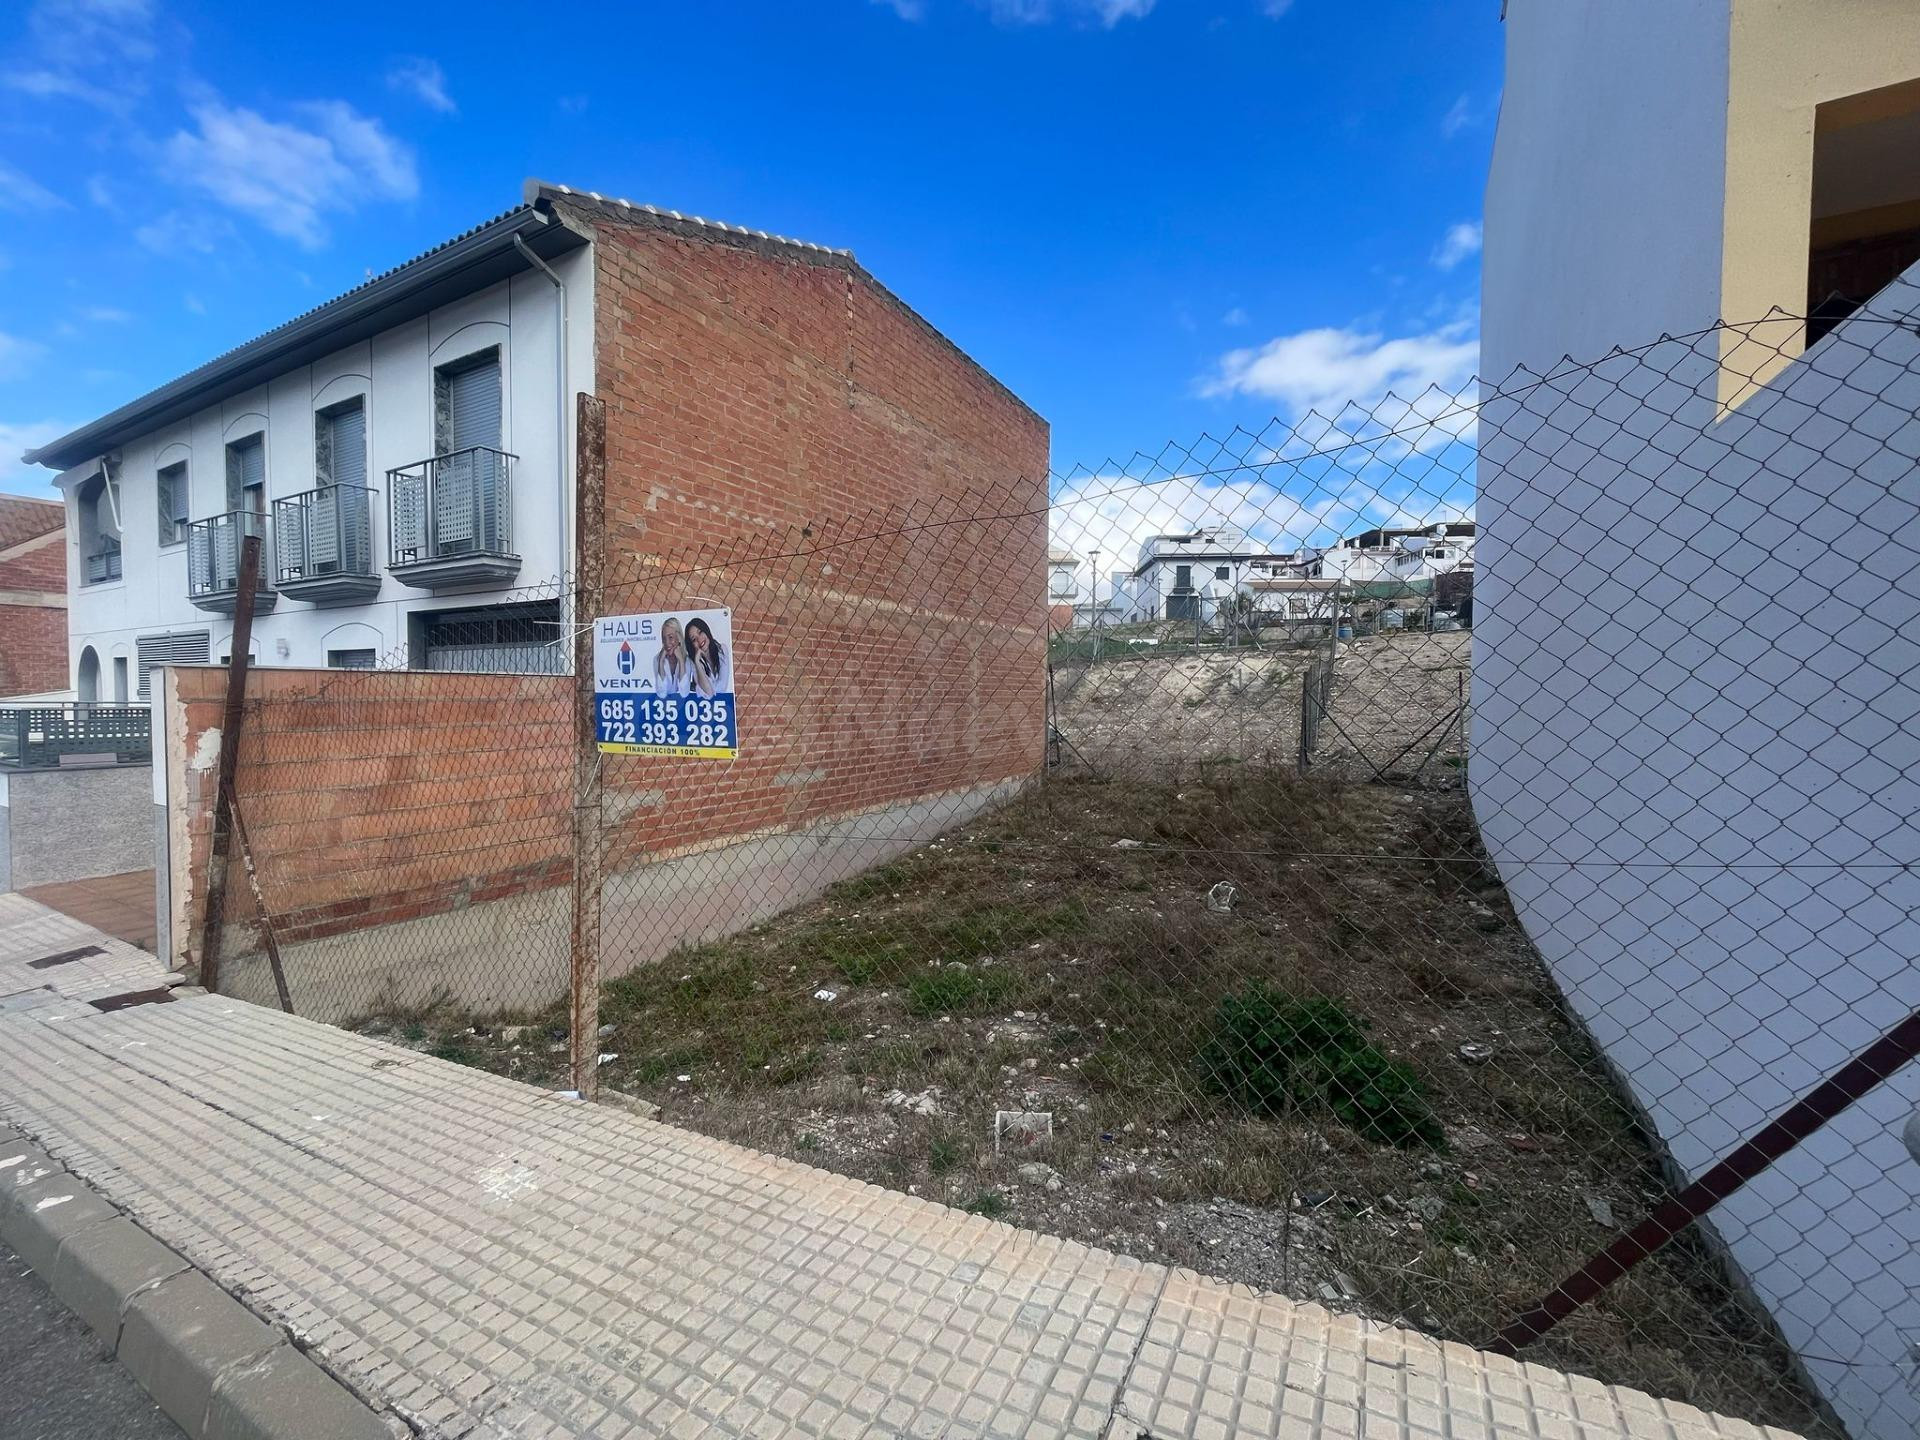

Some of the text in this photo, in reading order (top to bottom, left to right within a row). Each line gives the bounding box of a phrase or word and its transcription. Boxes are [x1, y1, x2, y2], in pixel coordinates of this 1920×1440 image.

[603, 620, 652, 636] HAUS
[600, 679, 652, 688] VENTA
[601, 699, 727, 722] 685 135 035
[602, 722, 728, 746] 722 393 282
